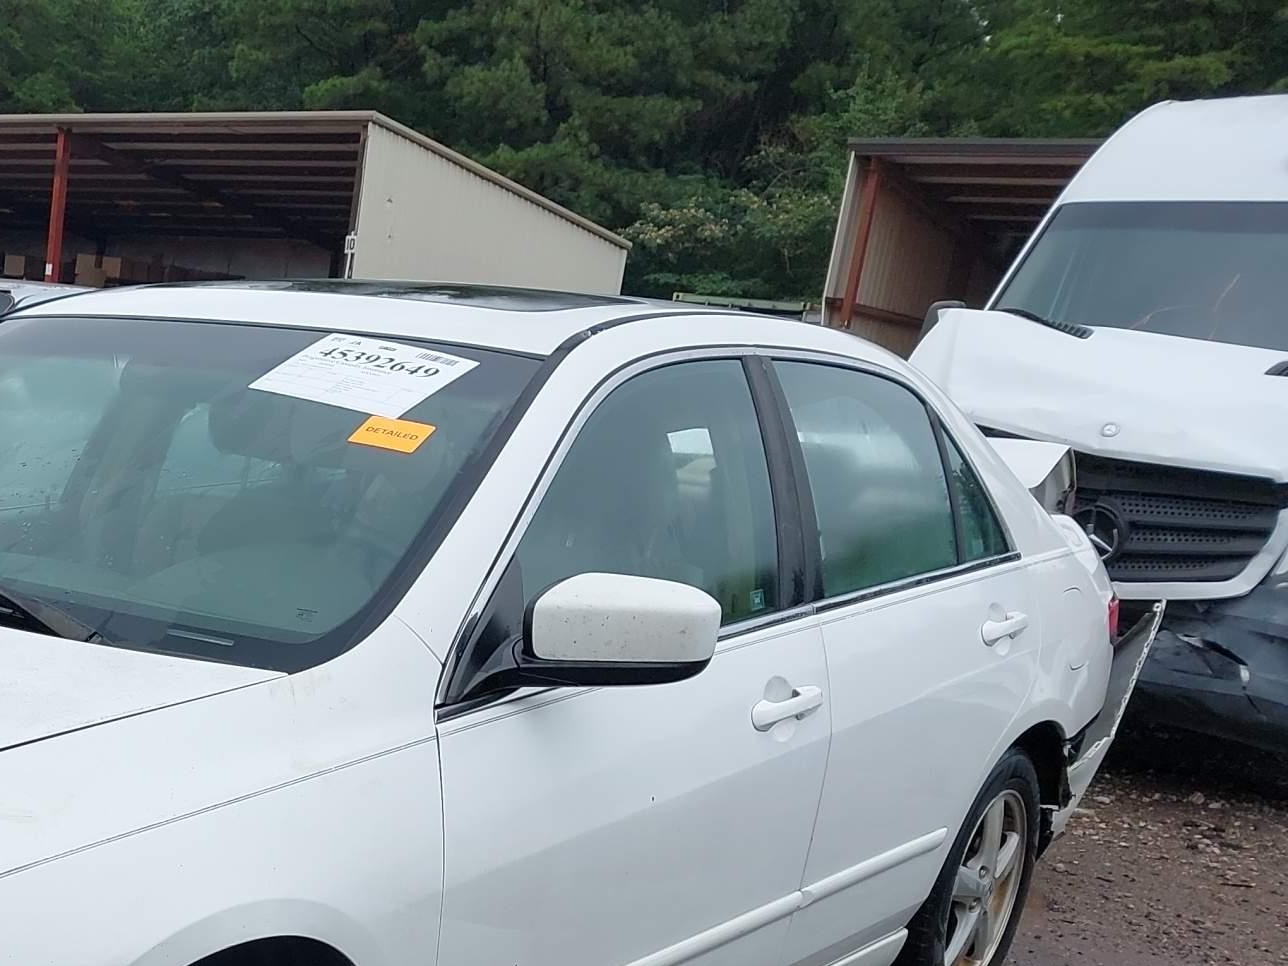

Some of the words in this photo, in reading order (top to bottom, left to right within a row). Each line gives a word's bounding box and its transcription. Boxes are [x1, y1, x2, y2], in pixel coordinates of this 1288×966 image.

[346, 238, 355, 250] 10
[319, 347, 441, 378] 45392649
[365, 425, 419, 442] DETAILED
